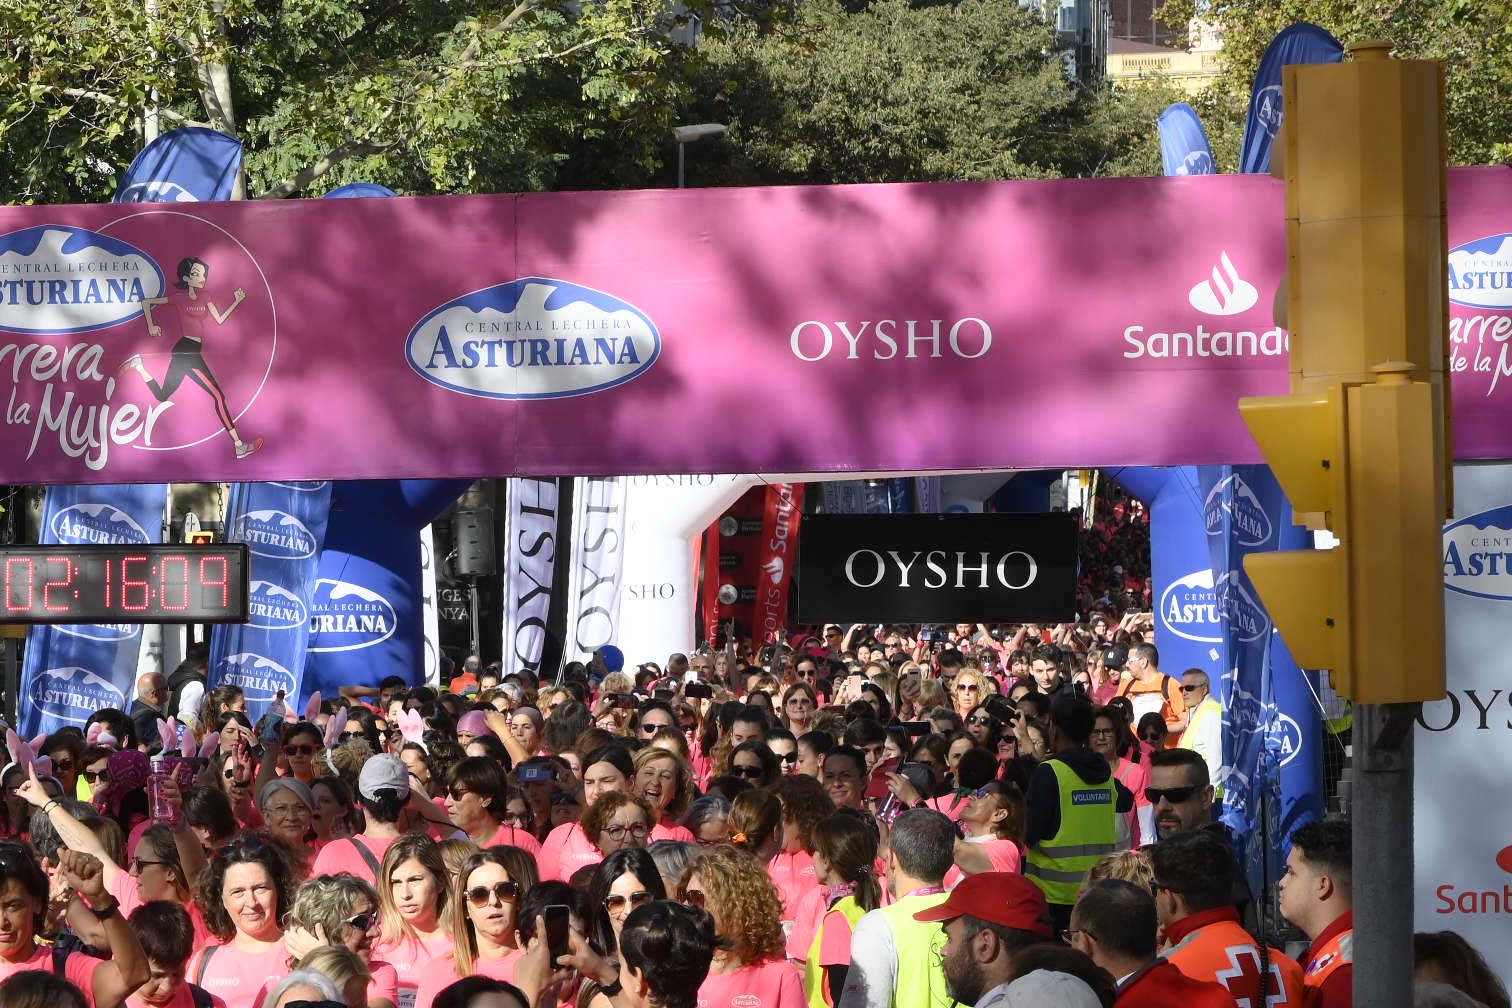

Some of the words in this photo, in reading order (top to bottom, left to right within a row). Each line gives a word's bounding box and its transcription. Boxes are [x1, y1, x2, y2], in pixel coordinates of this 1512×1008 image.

[67, 260, 140, 272] LECHERA
[425, 325, 641, 370] ASTURIANA
[464, 320, 544, 334] CENTRAL
[551, 318, 633, 331] LECHERA
[789, 316, 993, 362] OYSHO
[6, 382, 31, 426] la
[25, 376, 175, 471] Mujer
[5, 556, 227, 612] 02:16:09
[844, 548, 1038, 590] OYSHO
[334, 603, 384, 612] LECHERA
